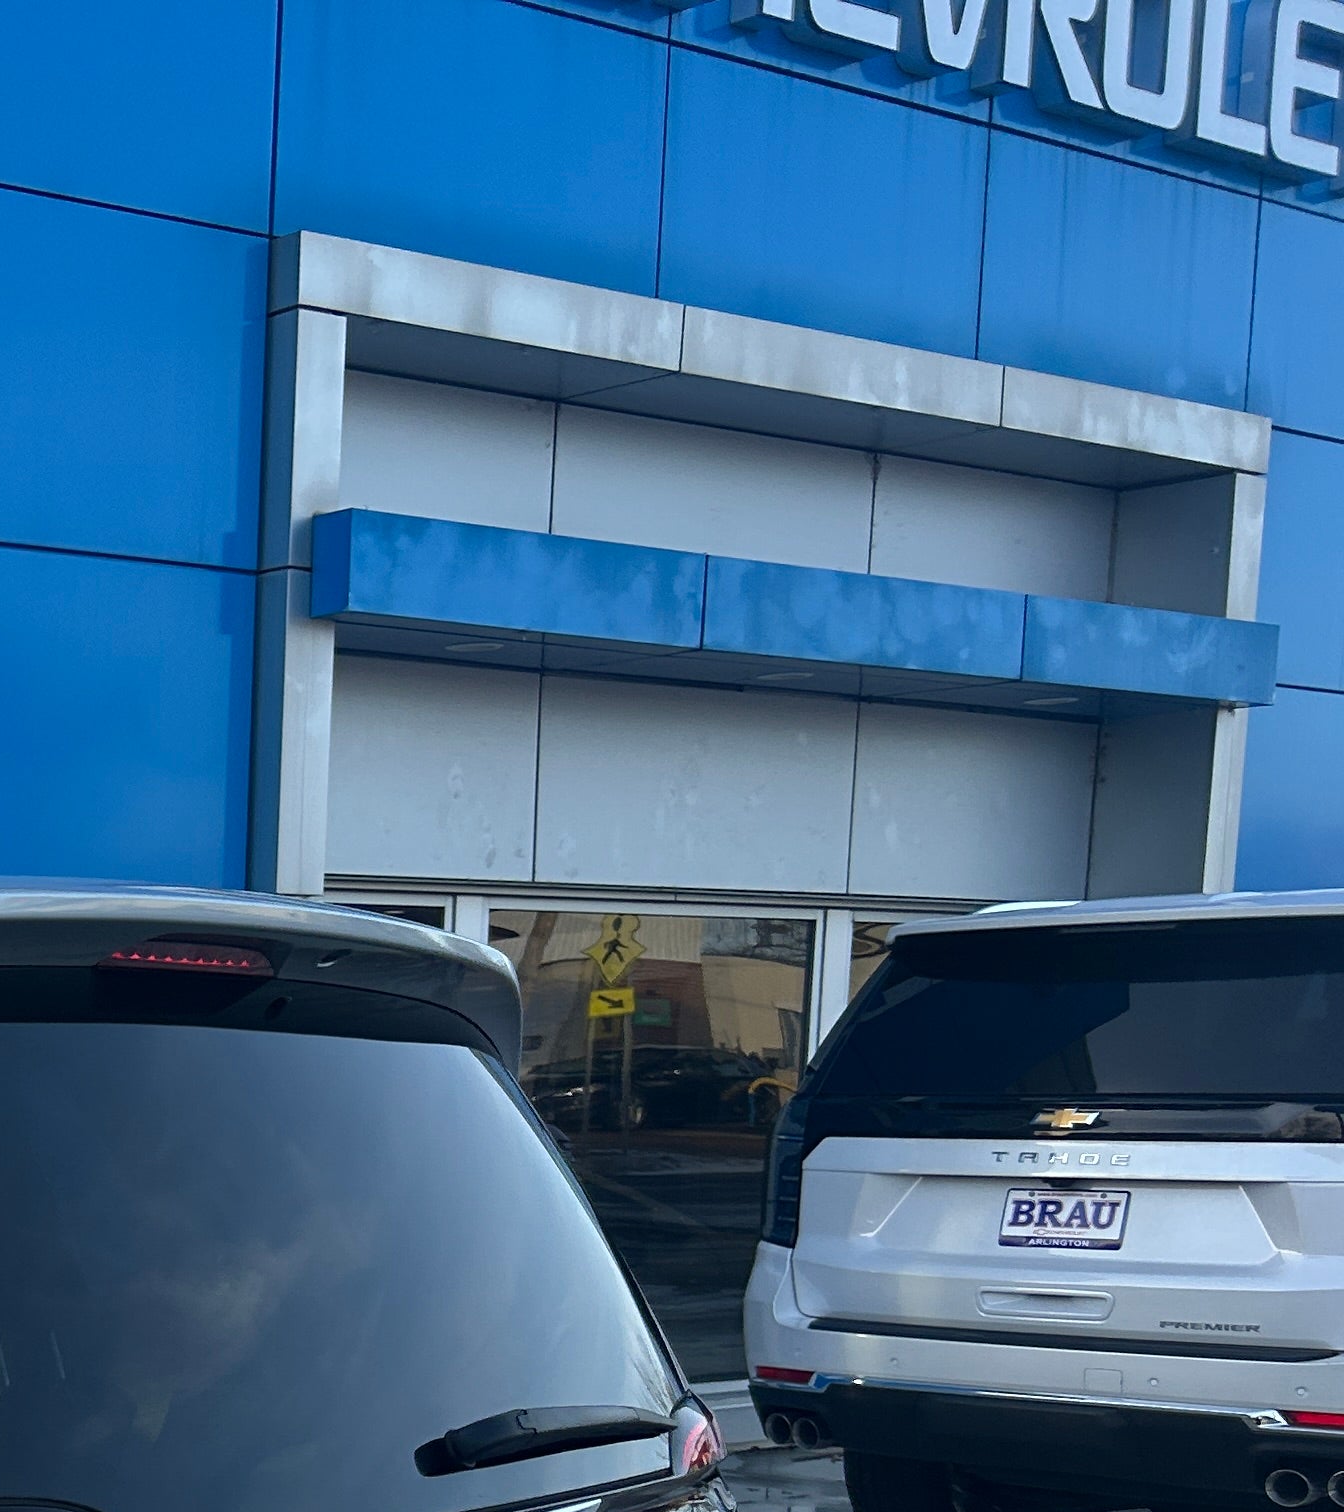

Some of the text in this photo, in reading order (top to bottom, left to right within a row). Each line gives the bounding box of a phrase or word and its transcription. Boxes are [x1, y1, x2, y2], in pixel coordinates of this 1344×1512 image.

[992, 1151, 1130, 1166] TAHOE
[1008, 1199, 1121, 1230] BRAU
[1028, 1237, 1089, 1247] ARLINGTON
[1159, 1320, 1261, 1333] PREMIER
